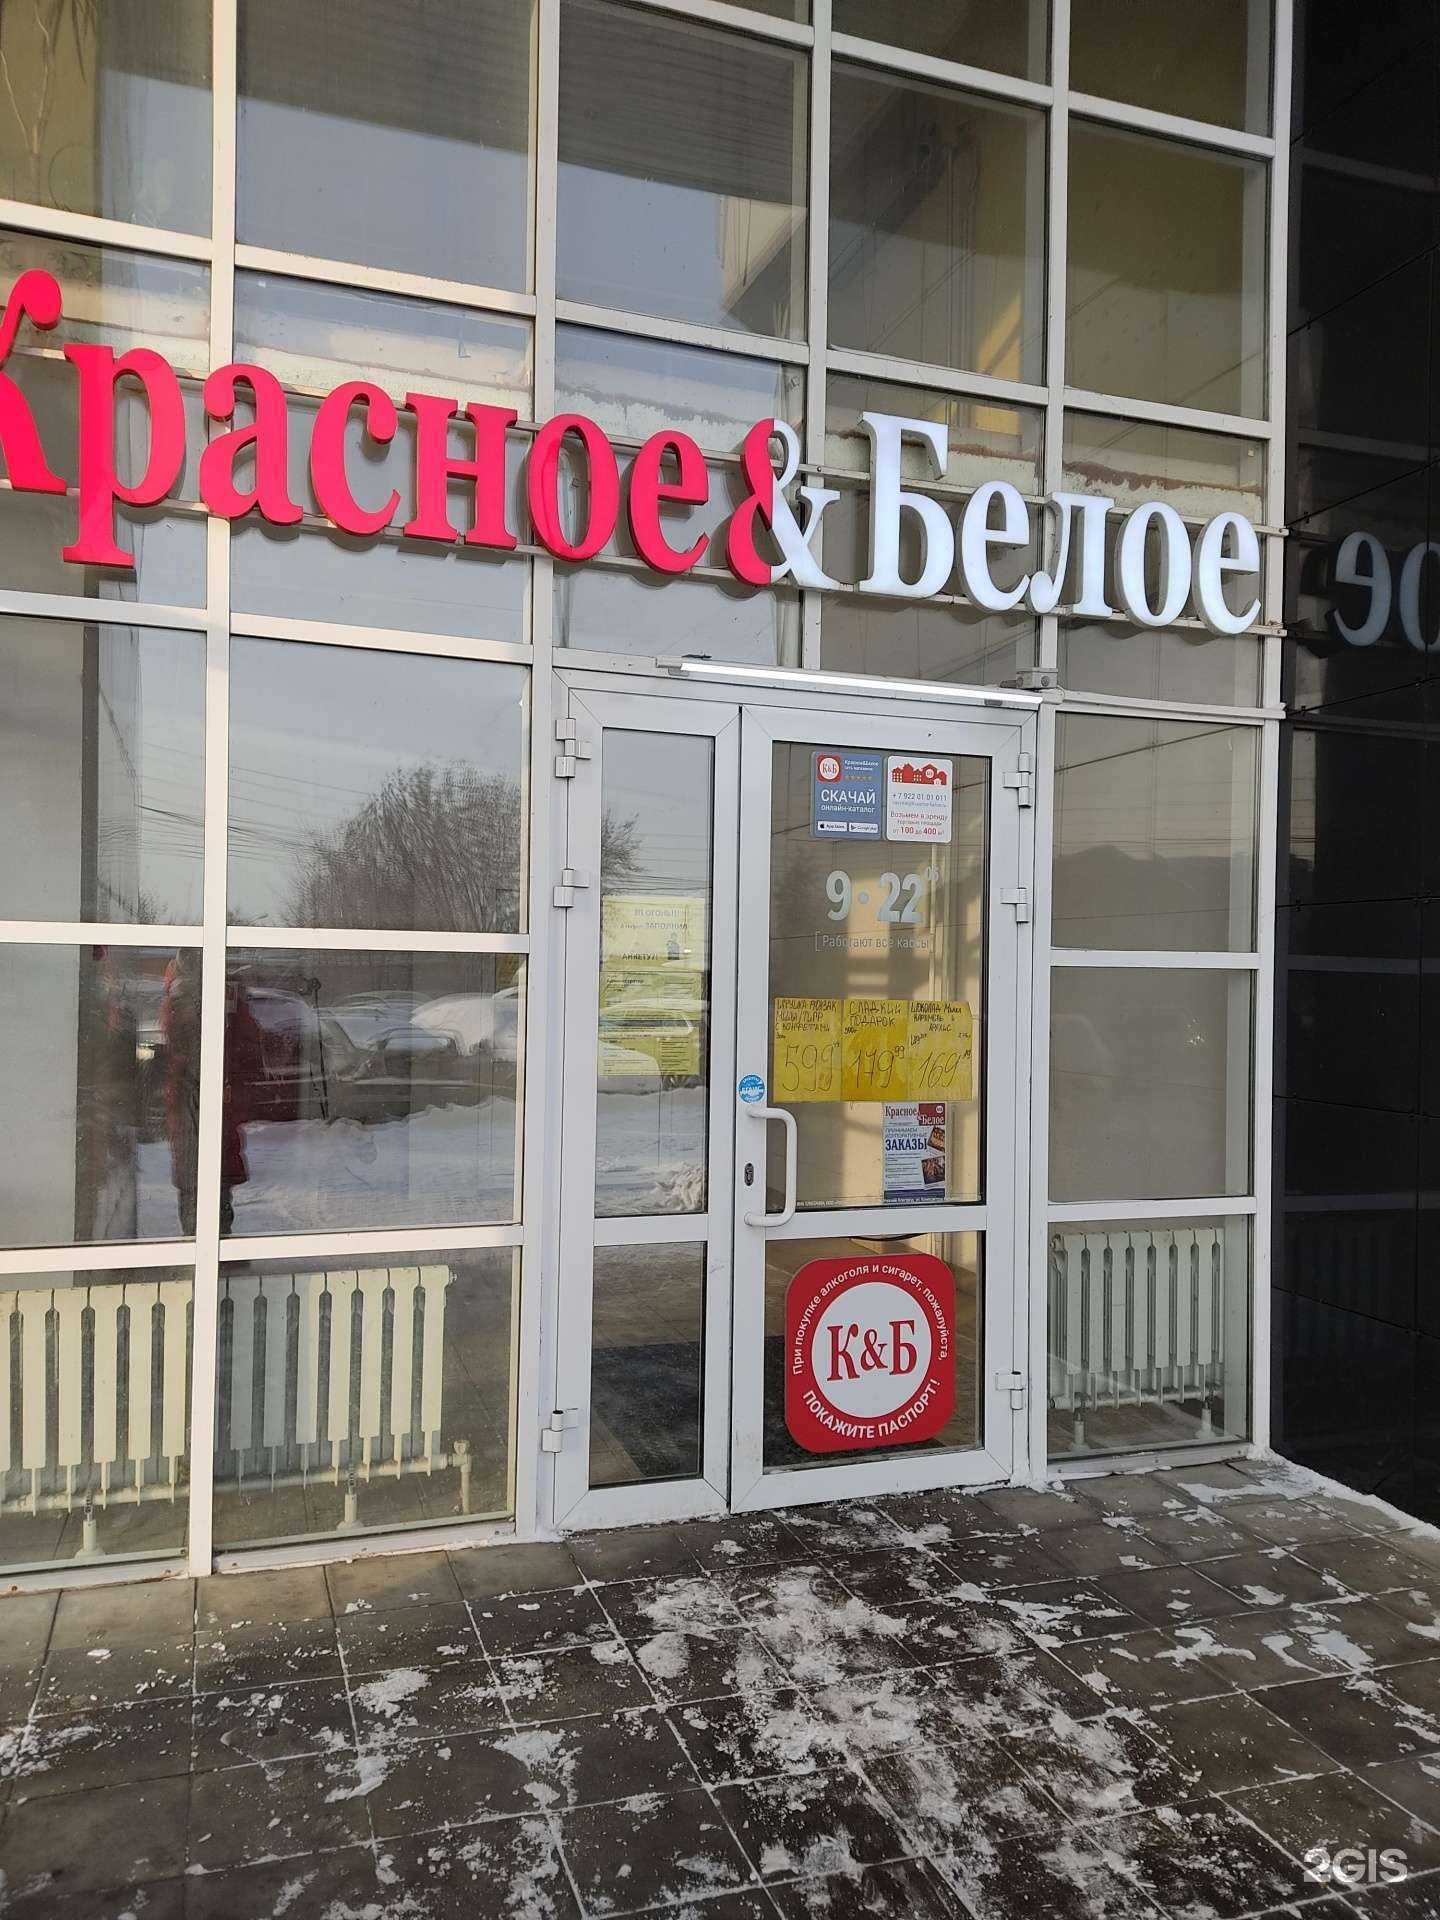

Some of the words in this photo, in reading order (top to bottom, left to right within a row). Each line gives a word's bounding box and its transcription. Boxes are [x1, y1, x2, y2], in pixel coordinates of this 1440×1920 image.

[821, 788, 876, 805] СКАЧАЙ
[821, 804, 876, 813] онлайн-каталог
[826, 870, 851, 921] 9
[877, 872, 924, 924] 22
[876, 938, 894, 948] все
[848, 1001, 901, 1015] СЛАДКИЙ
[848, 1014, 896, 1027] ПОДАРОК
[782, 1045, 834, 1092] 599
[849, 1048, 894, 1089] 179
[918, 1051, 961, 1089] 169
[885, 1106, 918, 1119] Красное
[922, 1114, 945, 1125] Белое
[885, 1138, 928, 1151] ЗАКАЗЫ
[819, 1264, 870, 1297] алкоголя
[872, 1264, 880, 1273] и
[881, 1264, 924, 1292] сигарет,
[794, 1296, 822, 1348] покупке
[922, 1287, 951, 1361] пожалуйста,
[792, 1347, 804, 1375] При
[826, 1318, 919, 1382] К&Б
[802, 1389, 875, 1439] ПОКАЖИТЕ
[878, 1378, 941, 1437] ПАСПОРТ!
